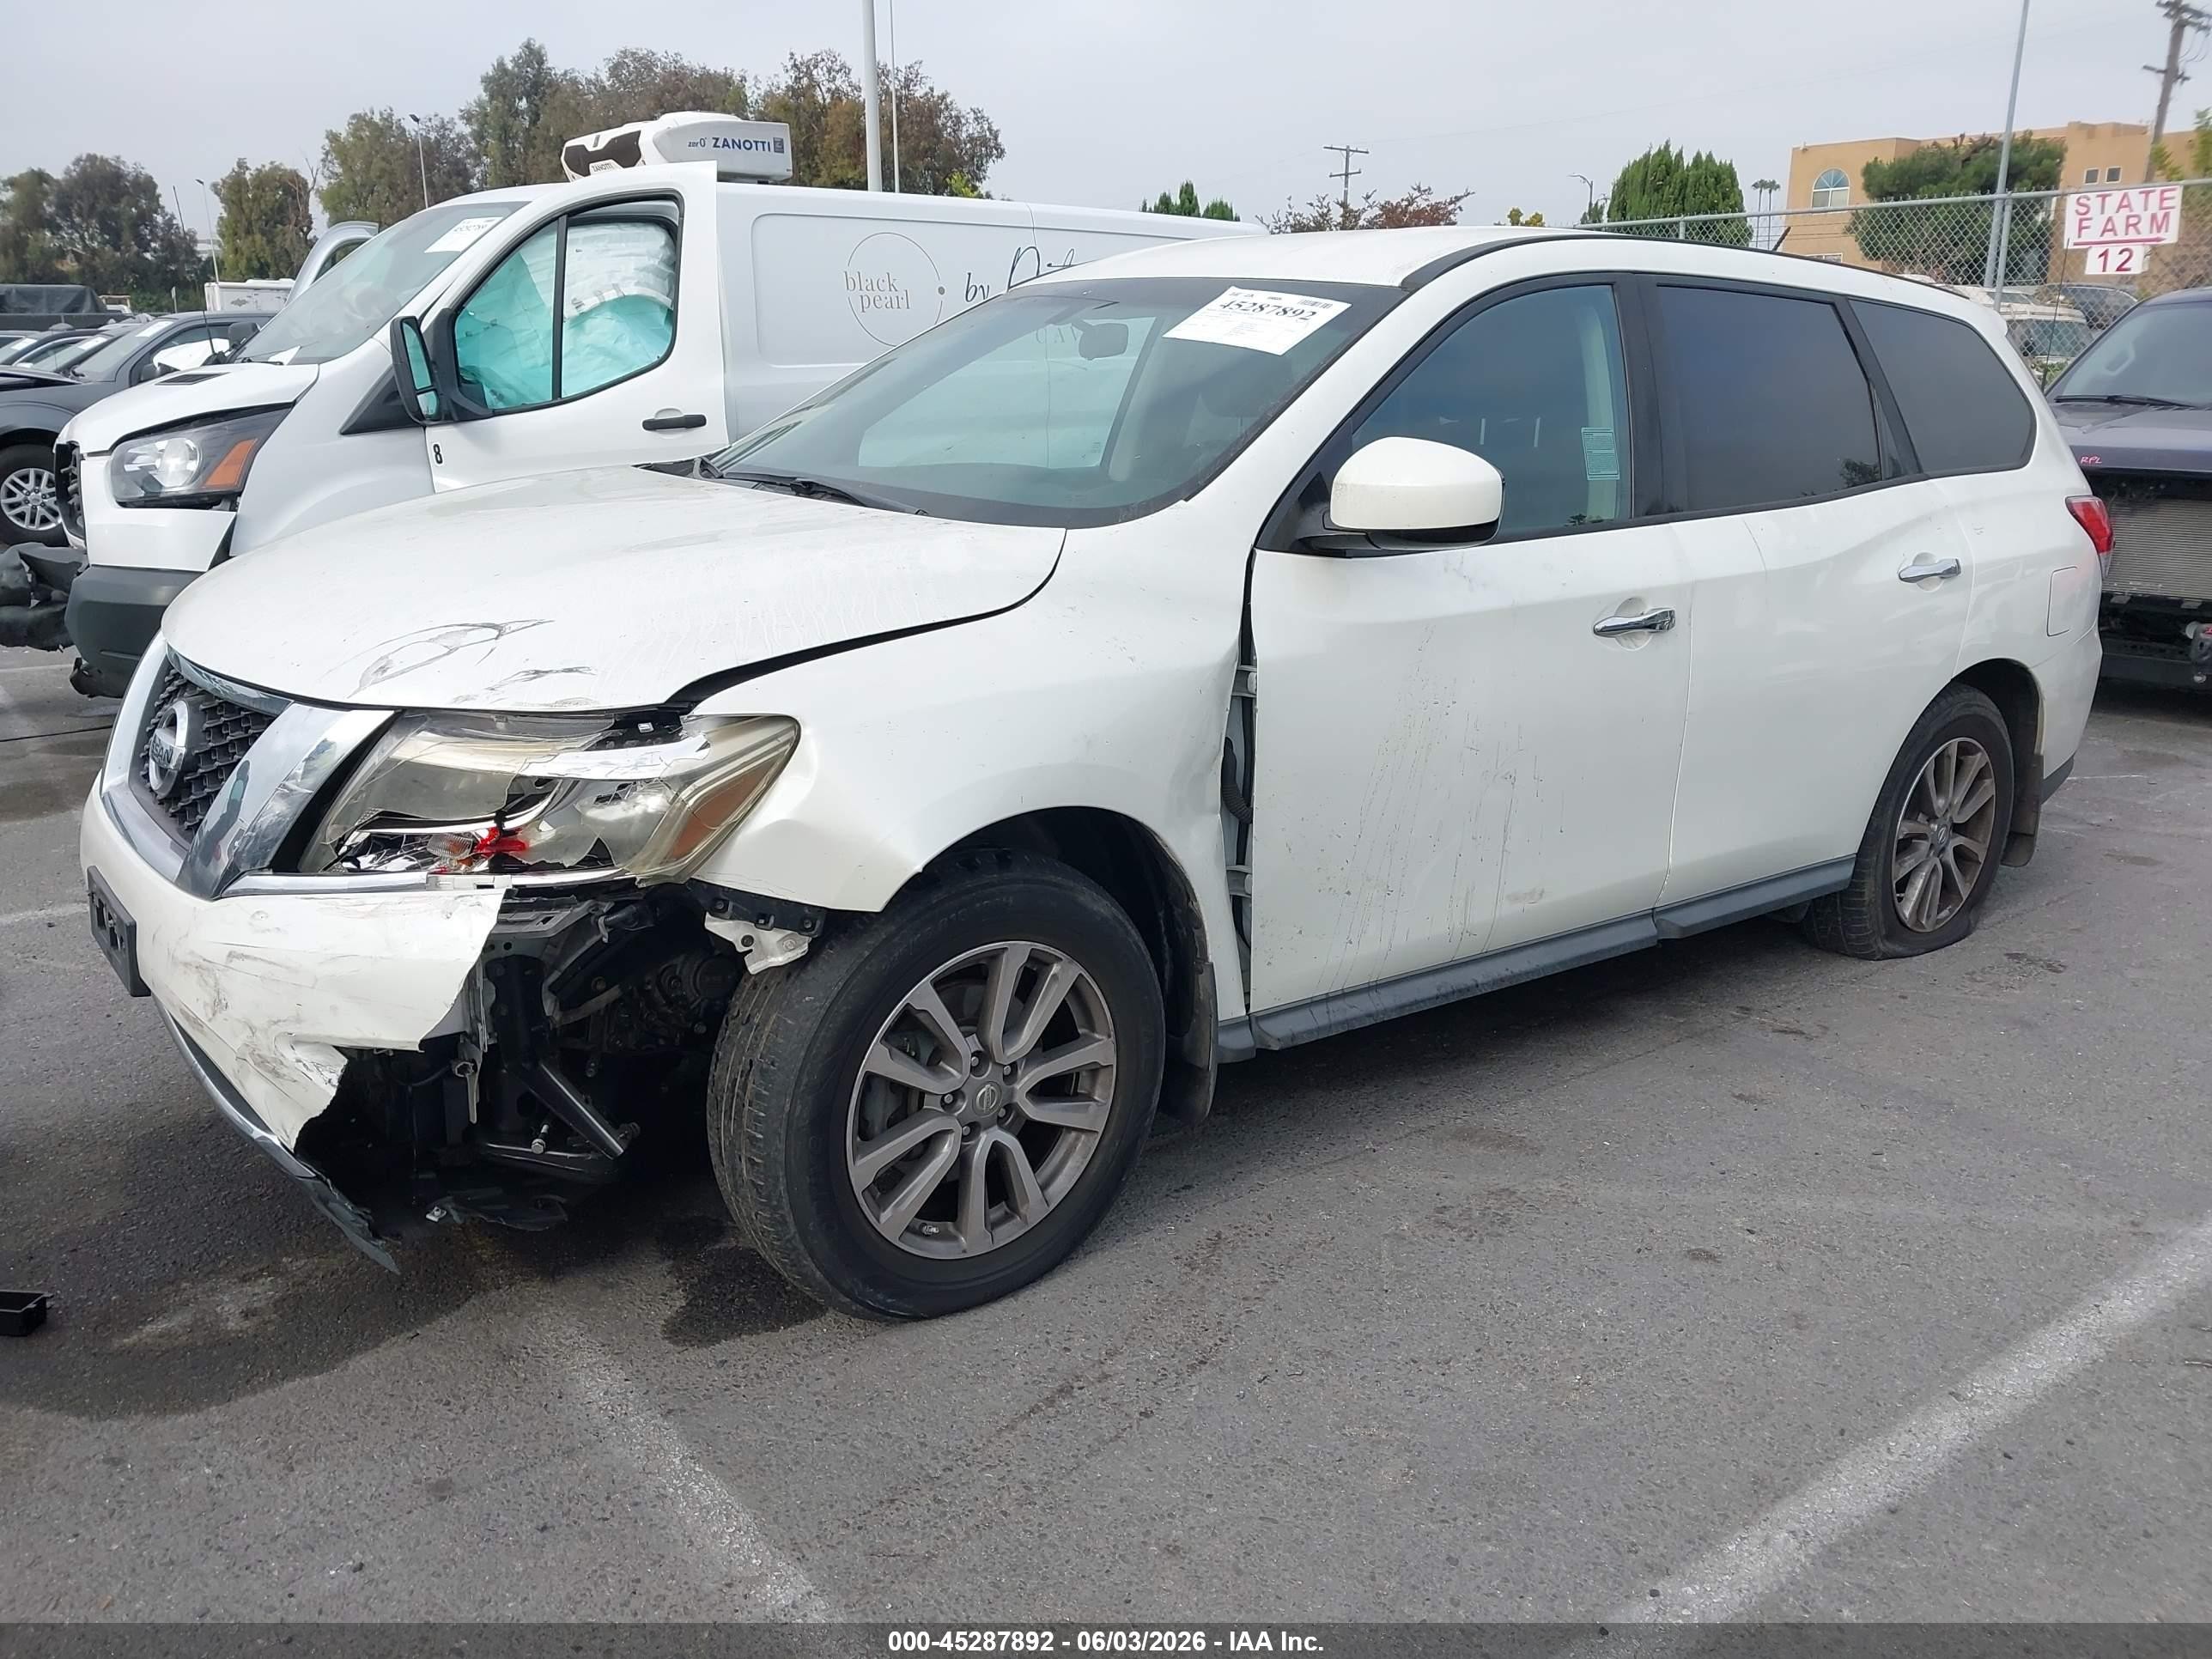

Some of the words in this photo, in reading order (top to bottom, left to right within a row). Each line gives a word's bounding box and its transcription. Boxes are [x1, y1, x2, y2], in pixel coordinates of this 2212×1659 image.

[712, 137, 771, 152] ZANOTTI
[2075, 188, 2177, 216] STATE
[2077, 211, 2171, 238] FARM
[2098, 247, 2134, 273] 12
[844, 271, 899, 292] black
[859, 289, 911, 313] pearl
[1219, 301, 1317, 321] 45287892
[433, 443, 443, 465] 8
